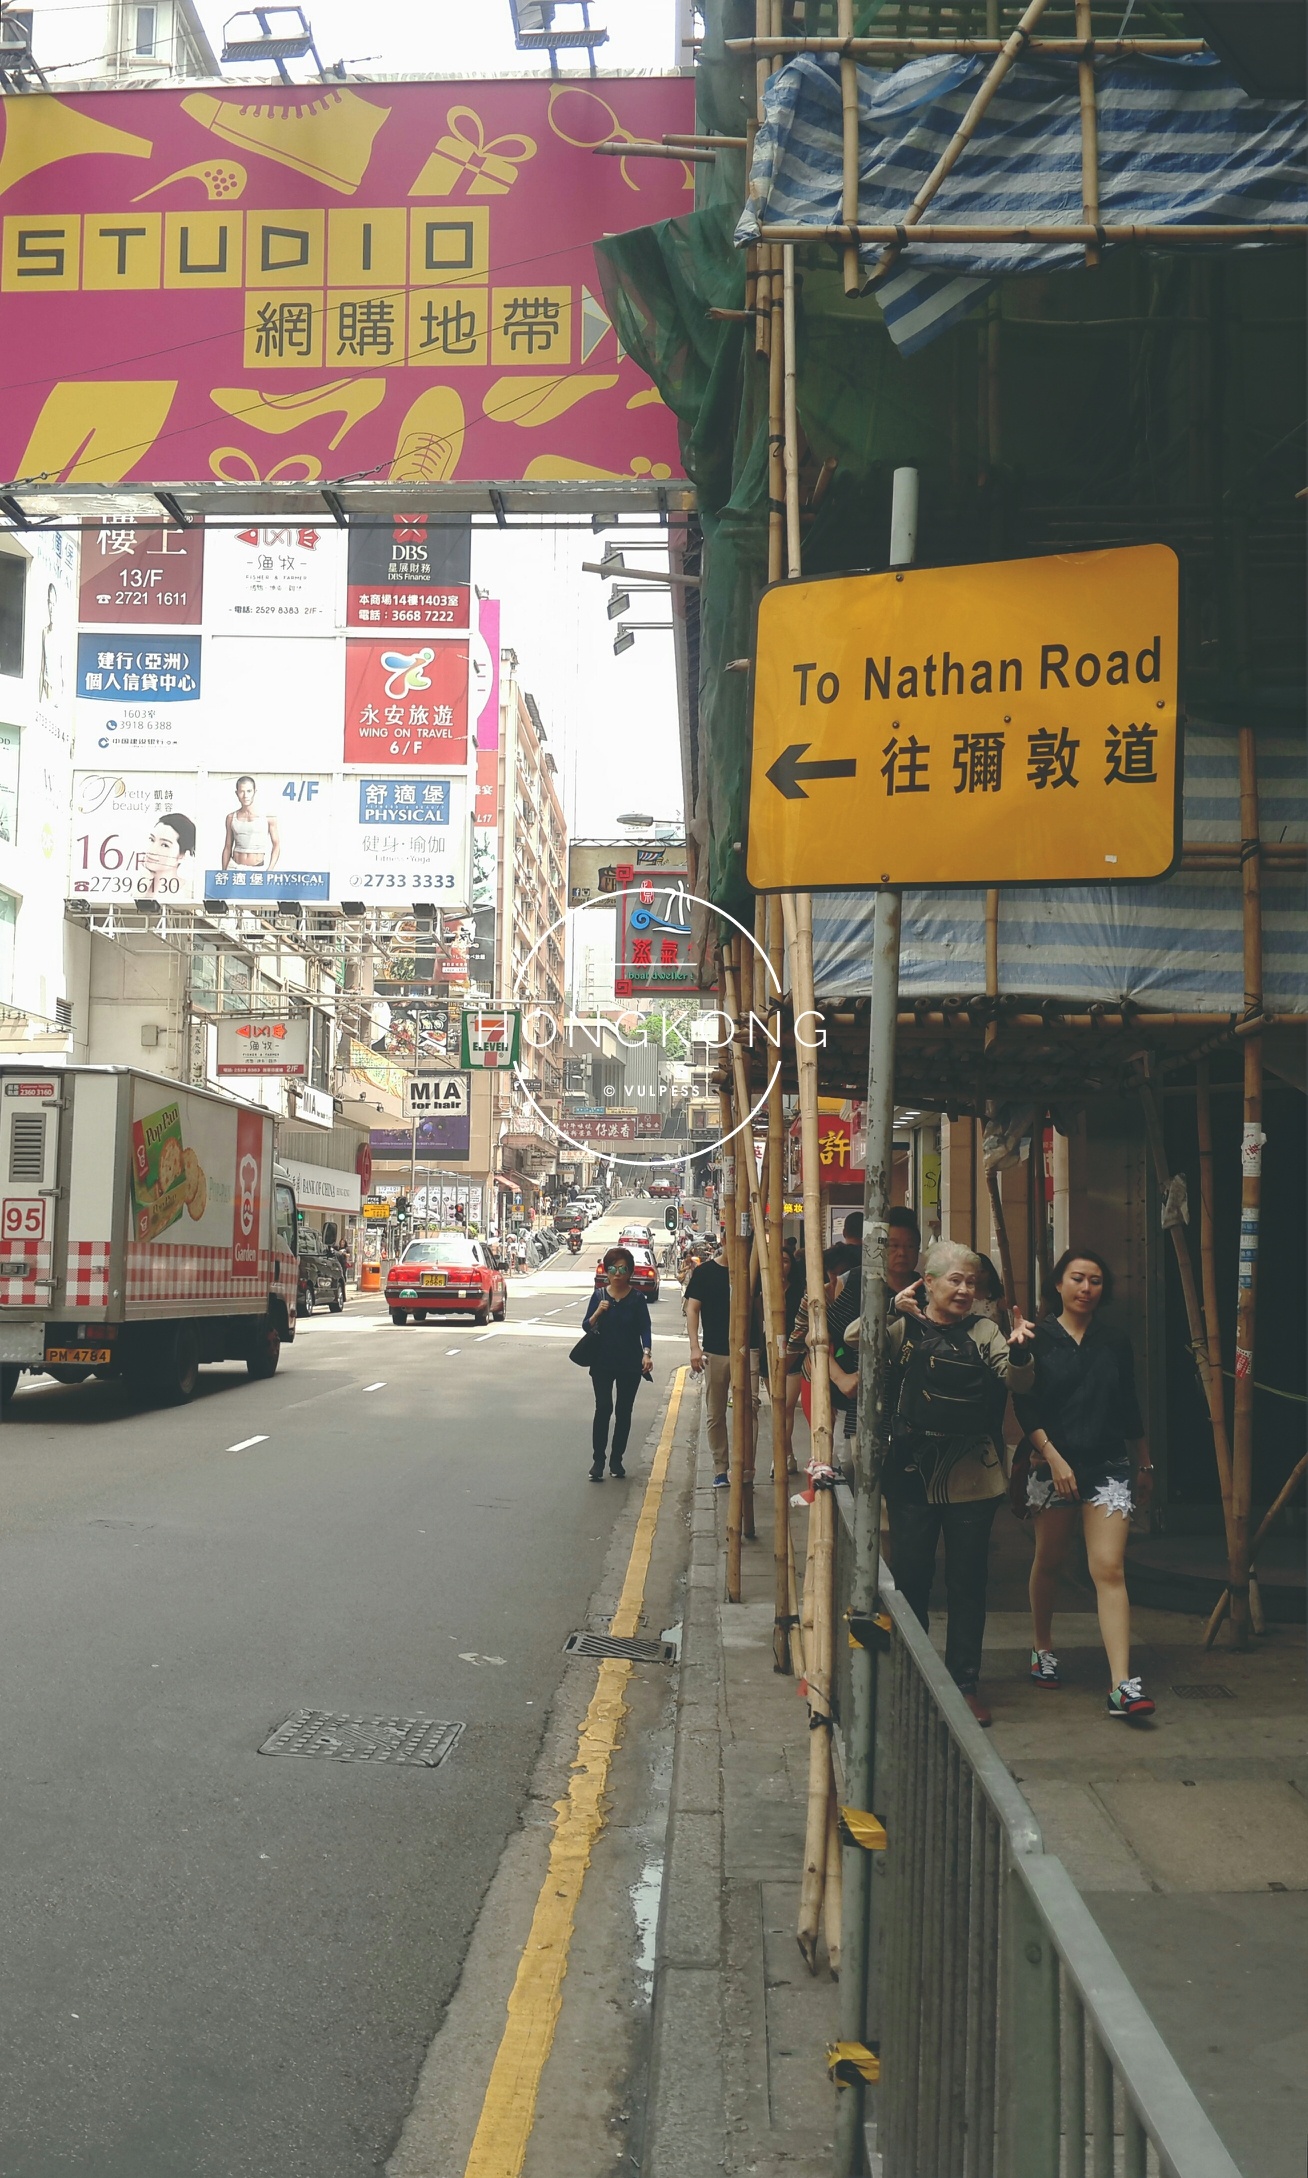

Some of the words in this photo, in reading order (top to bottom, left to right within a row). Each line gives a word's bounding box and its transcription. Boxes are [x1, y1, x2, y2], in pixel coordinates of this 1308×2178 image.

[17, 221, 474, 277] STUDIO
[255, 297, 560, 358] 網購地帶
[392, 545, 428, 560] DBS
[388, 562, 431, 573] 星展財務
[119, 569, 164, 588] 13/F
[115, 592, 148, 605] 2721
[156, 592, 187, 605] 1611
[255, 606, 275, 614] 2529
[391, 610, 421, 622] 3668
[424, 610, 454, 622] 7222
[792, 662, 840, 706] To
[864, 651, 1023, 701] Nathan
[1040, 635, 1162, 690] Road
[85, 672, 197, 692] 個人信貸中心
[359, 704, 454, 726] 永安旅遊
[359, 727, 388, 738] WING
[394, 728, 411, 738] ON
[417, 728, 453, 739] TRAVEL
[880, 722, 1159, 796] 往彌敦道
[282, 780, 320, 802] 4/F
[365, 783, 445, 805] 舒適堡
[112, 800, 151, 814] beauty
[365, 809, 444, 822] PHYSICAL
[90, 876, 133, 893] 2739
[136, 877, 180, 894] 6130
[214, 872, 264, 886] 舒適堡
[266, 873, 324, 884] PHYSICAL
[363, 874, 407, 888] 2733
[412, 874, 455, 888] 3333
[410, 1082, 461, 1100] MIA
[411, 1101, 431, 1110] for
[433, 1101, 462, 1110] hair
[818, 1129, 851, 1168] 許
[6, 1207, 41, 1231] 95
[235, 1243, 257, 1262] Garden
[50, 1351, 68, 1362] PM
[73, 1351, 107, 1362] 4784
